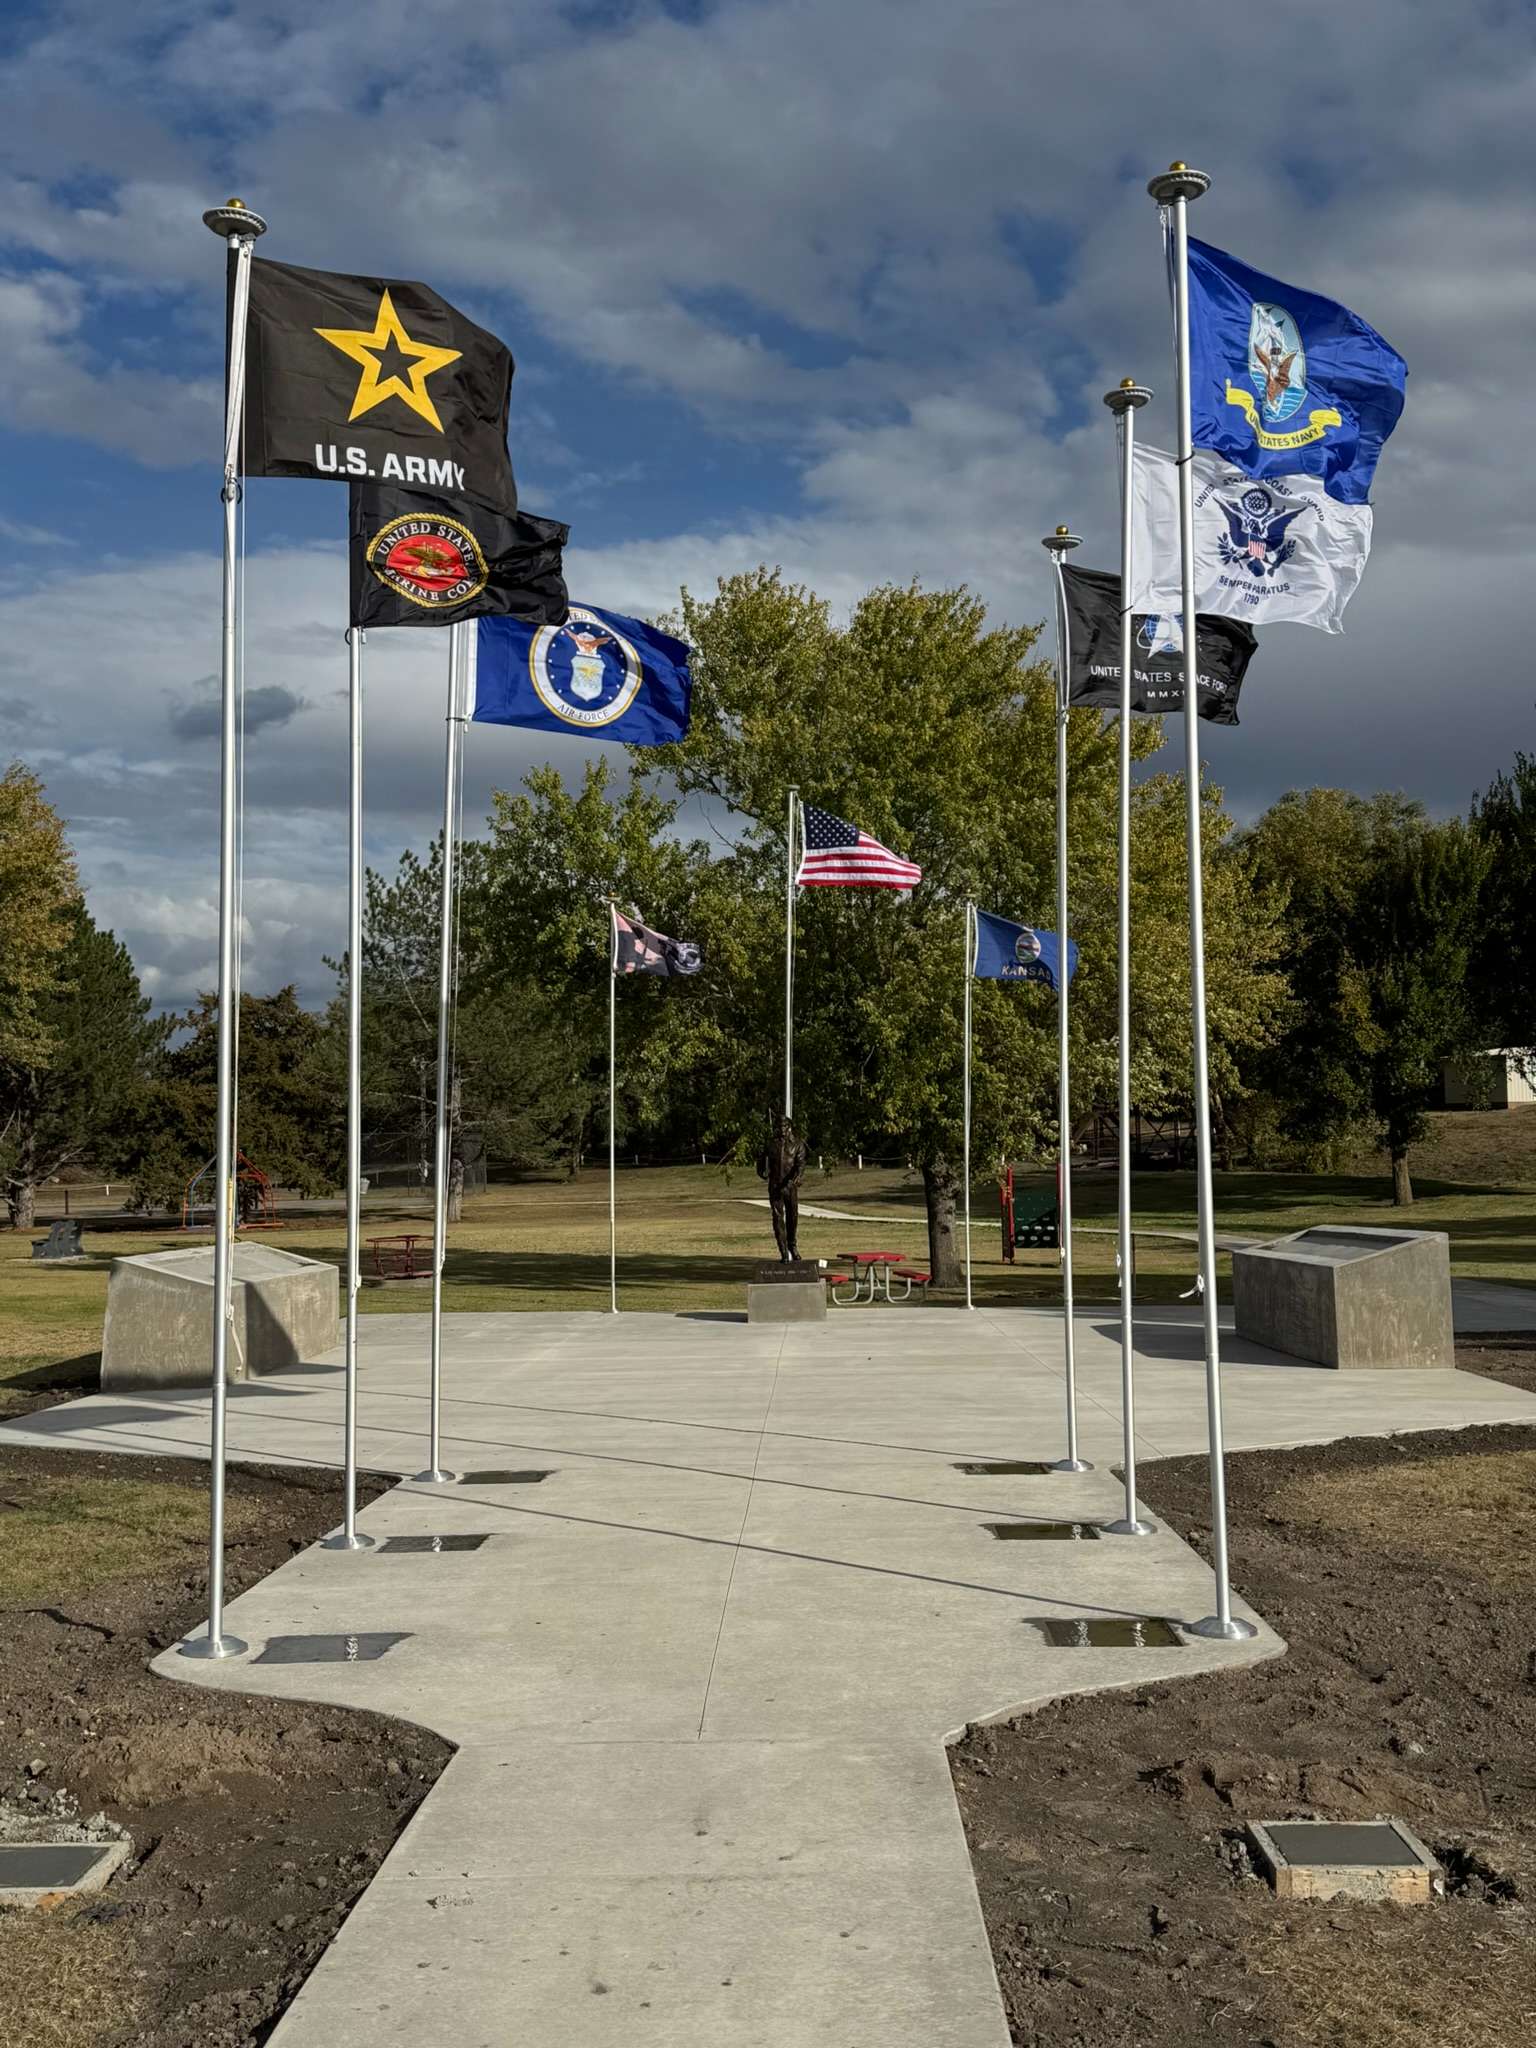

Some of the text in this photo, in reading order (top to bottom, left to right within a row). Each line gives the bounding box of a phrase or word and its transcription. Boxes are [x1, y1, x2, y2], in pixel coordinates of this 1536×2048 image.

[1291, 427, 1320, 444] NAVY
[315, 443, 465, 491] U.S. ARMY
[1193, 483, 1216, 508] UNITD
[1265, 476, 1293, 497] COAST
[377, 522, 431, 555] UNITED
[1243, 592, 1260, 605] 1790
[1090, 665, 1122, 678] UNITE
[1133, 669, 1172, 682] STATES
[1178, 671, 1211, 687] SCE
[558, 703, 609, 721] AIR FORCE
